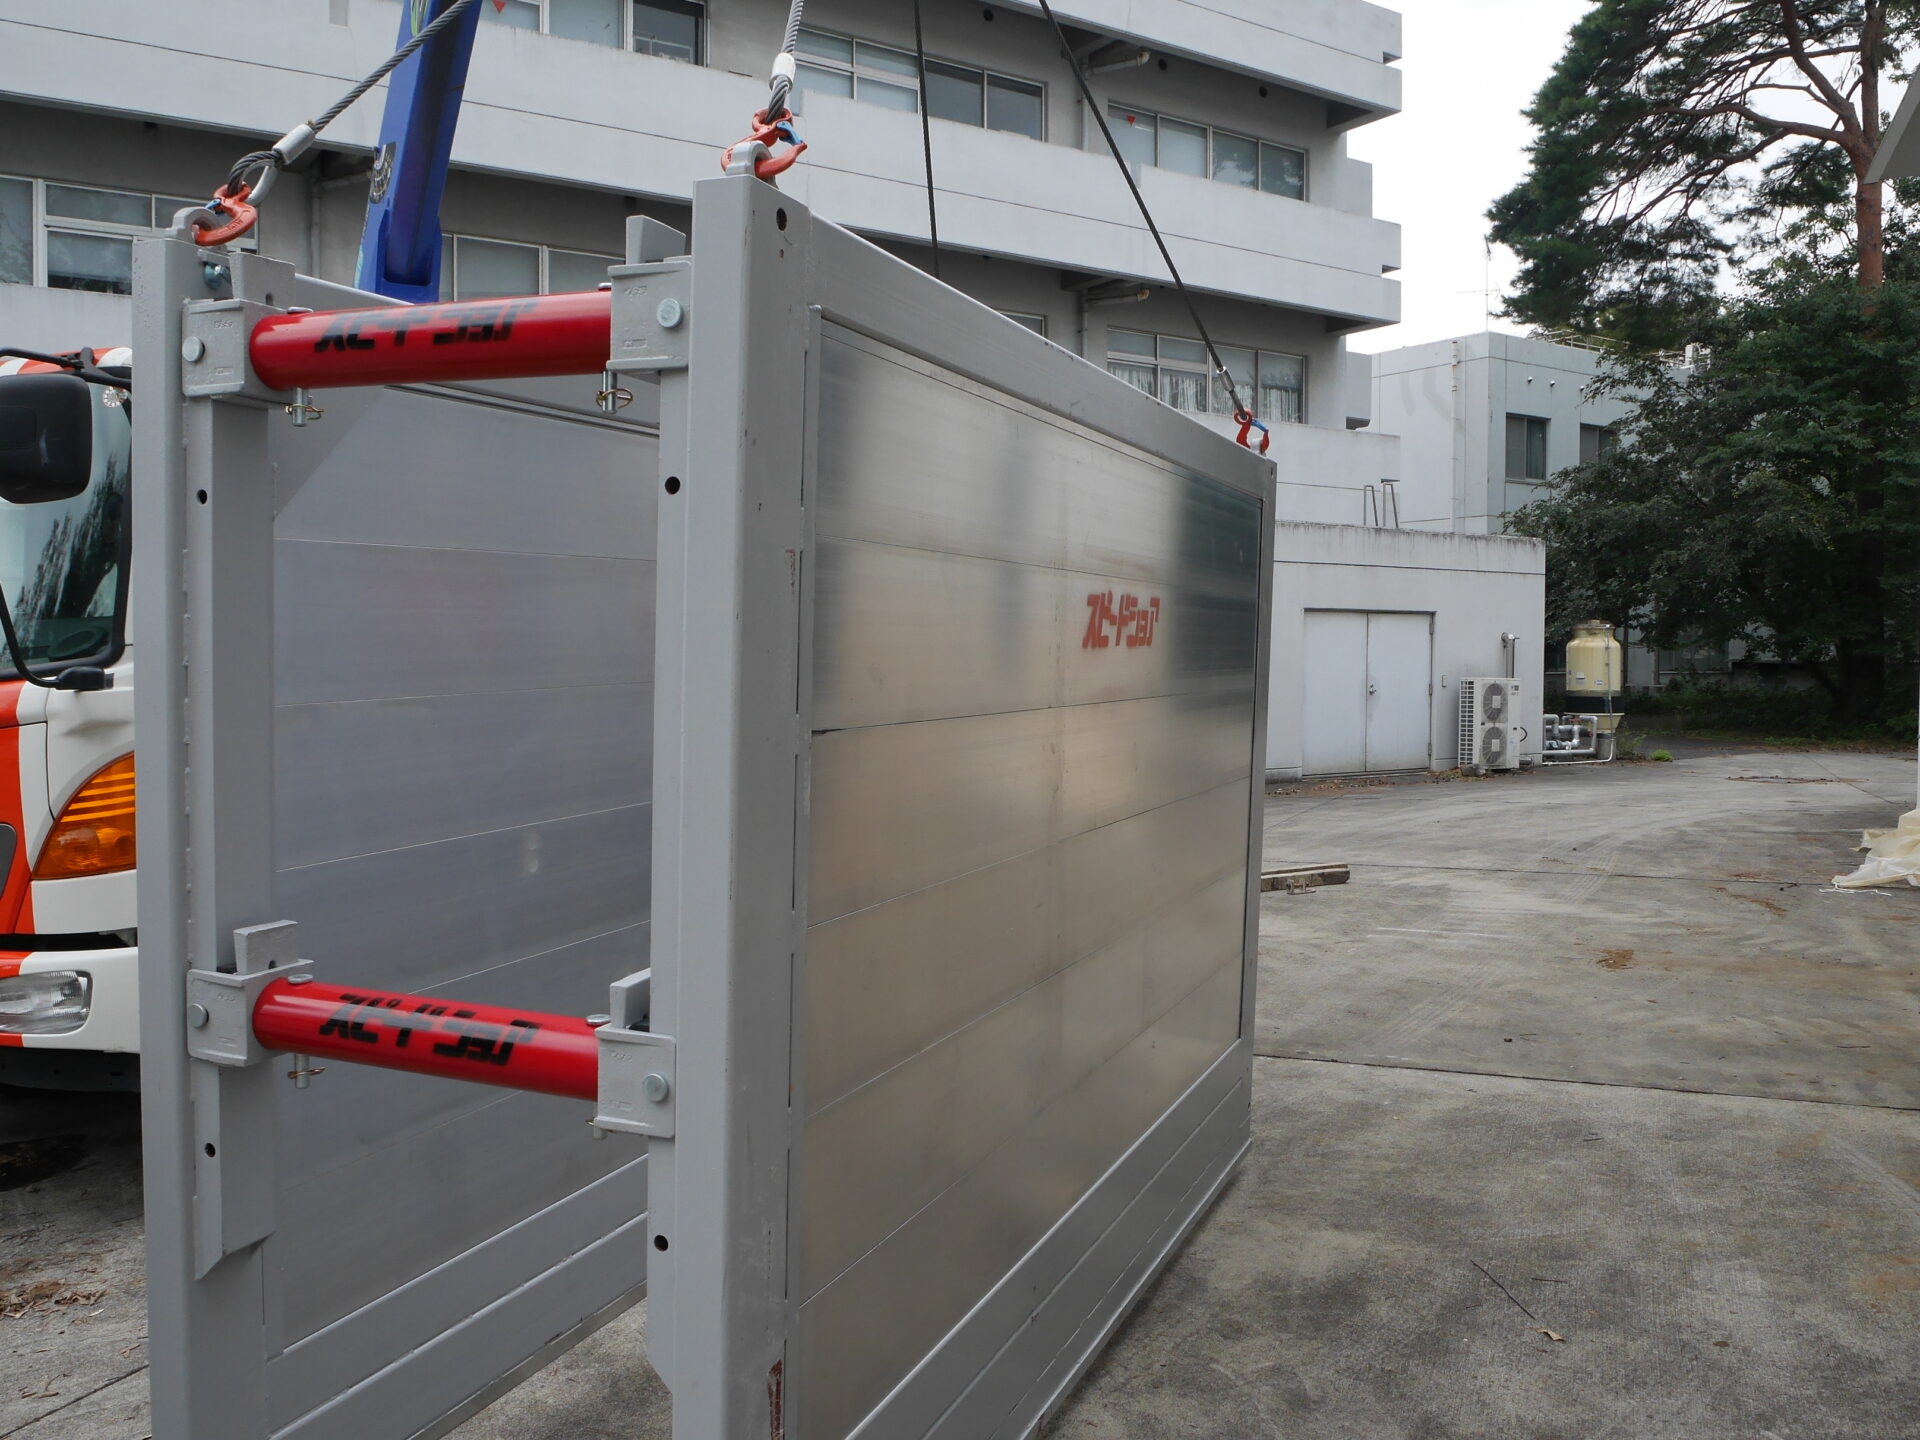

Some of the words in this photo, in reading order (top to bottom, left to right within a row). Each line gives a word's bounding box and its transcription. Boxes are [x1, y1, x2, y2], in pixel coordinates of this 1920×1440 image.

[1082, 589, 1160, 649] スピードショア
